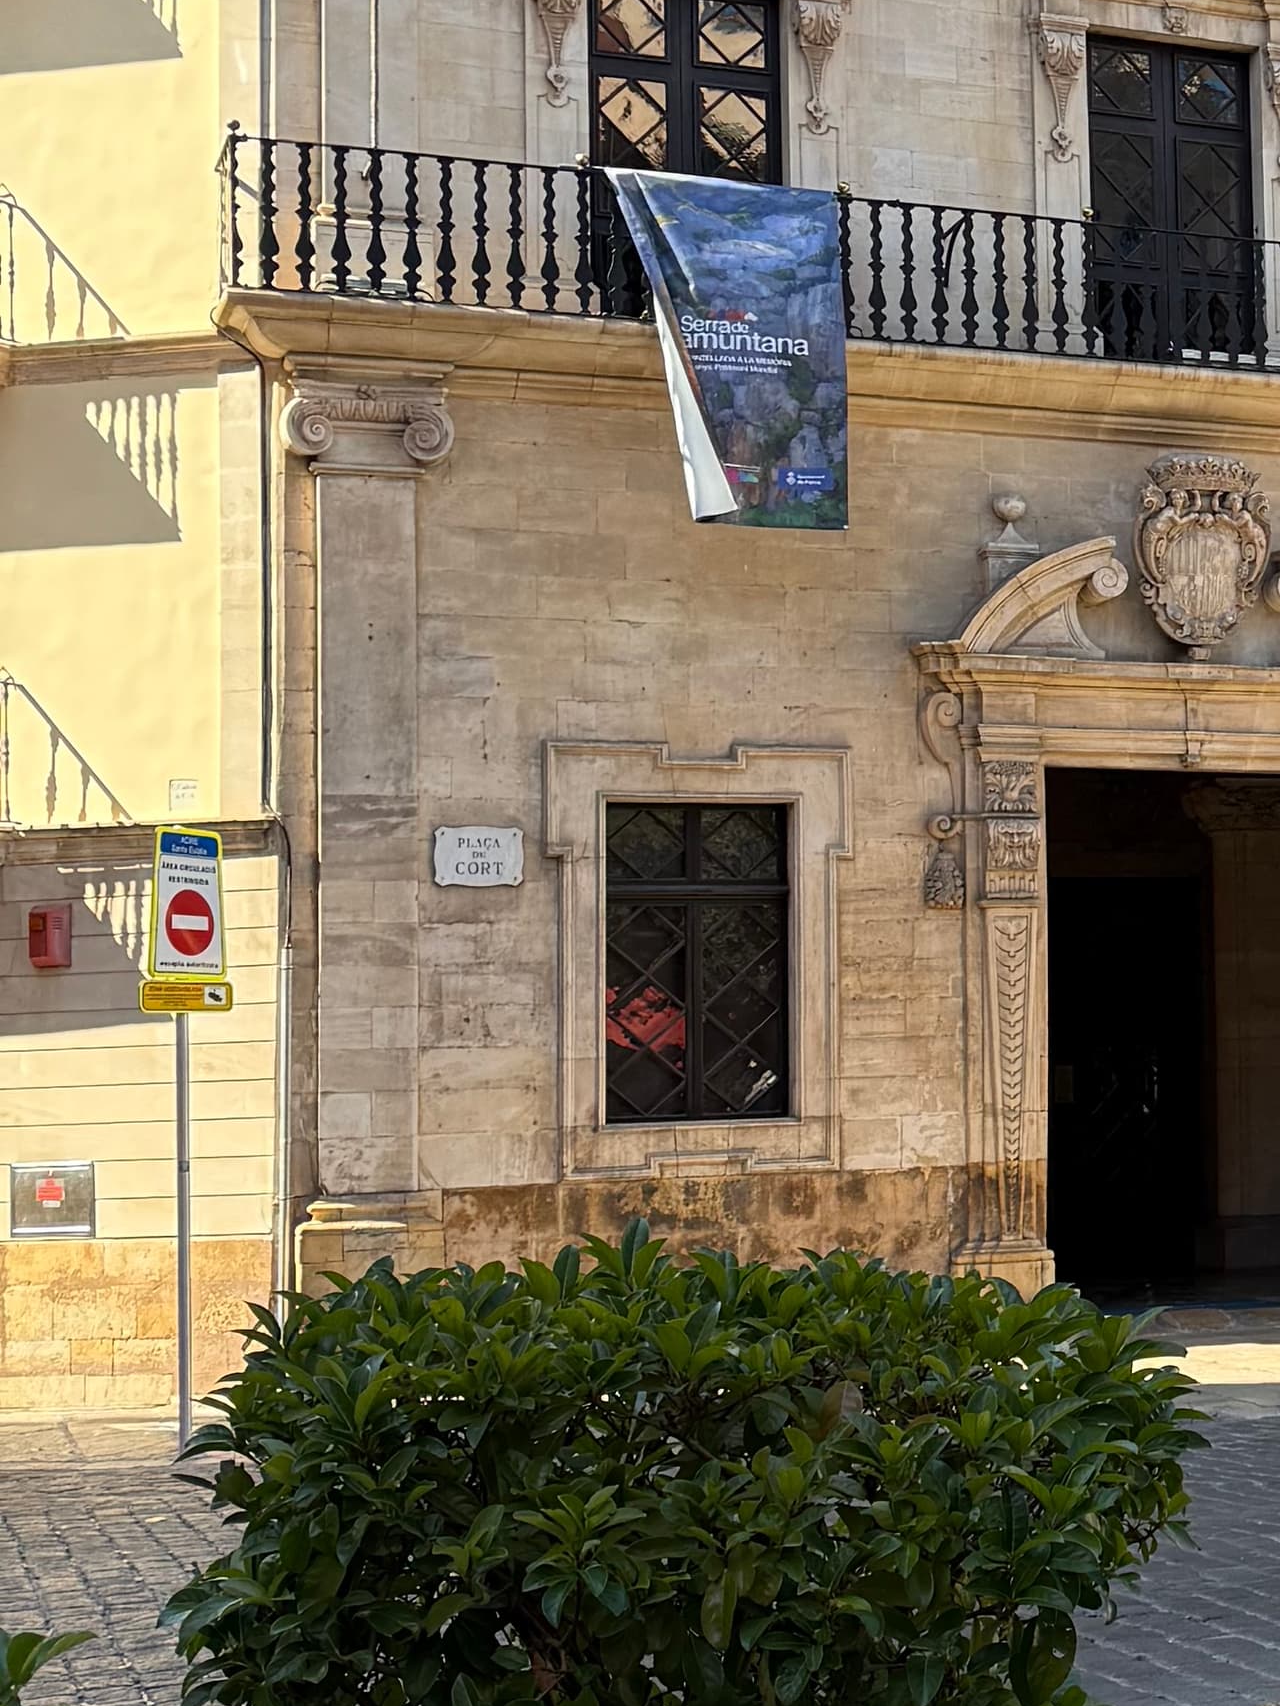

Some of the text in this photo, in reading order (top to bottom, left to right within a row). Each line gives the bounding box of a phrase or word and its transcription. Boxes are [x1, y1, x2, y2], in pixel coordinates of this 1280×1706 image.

[681, 315, 731, 334] Serra
[682, 332, 809, 356] amuntana
[458, 837, 501, 851] PLAÇA
[472, 851, 487, 859] DE
[455, 861, 503, 875] CORT
